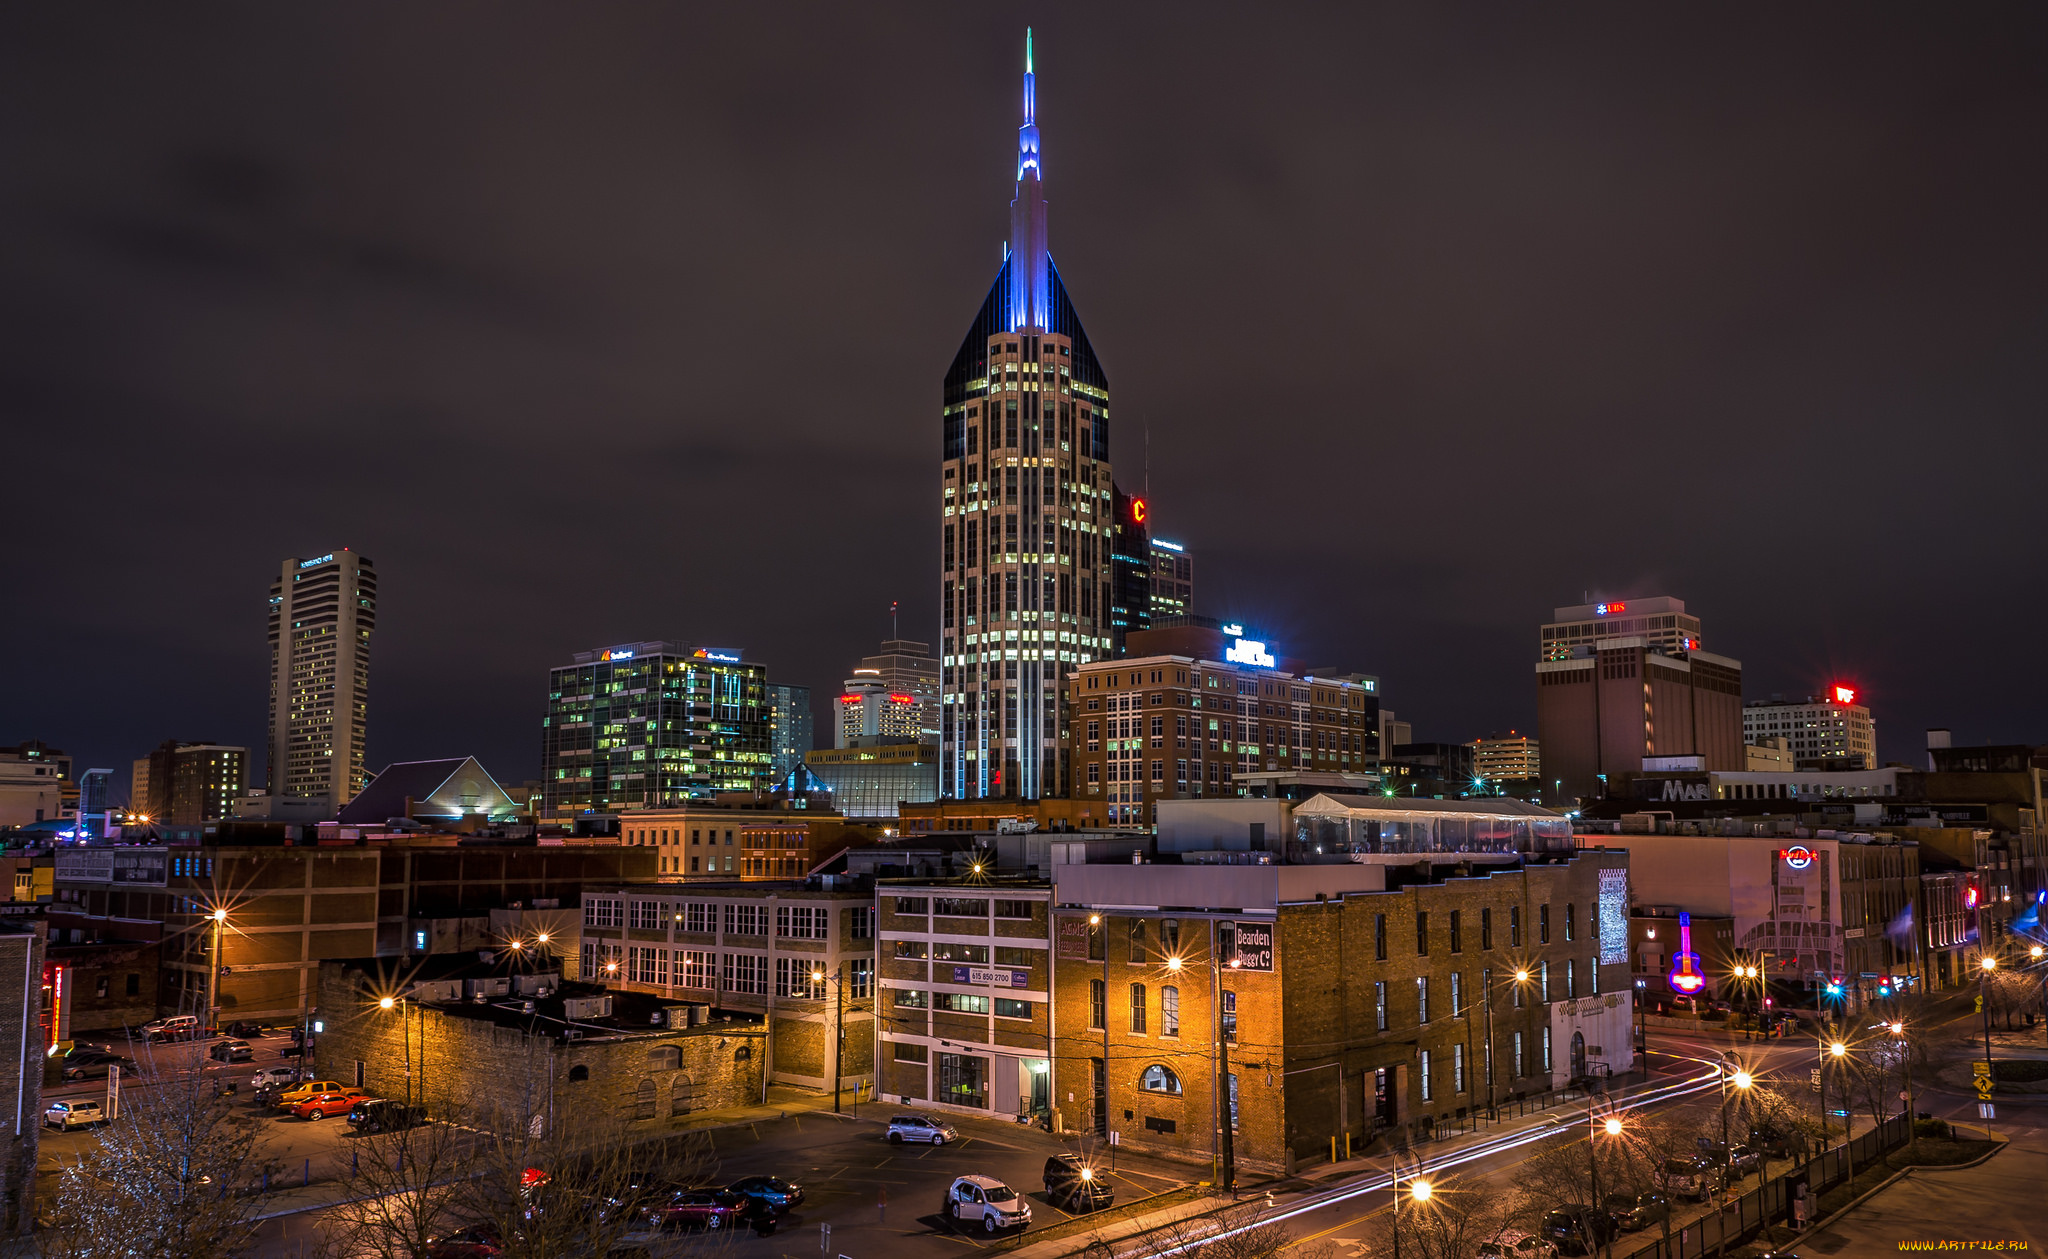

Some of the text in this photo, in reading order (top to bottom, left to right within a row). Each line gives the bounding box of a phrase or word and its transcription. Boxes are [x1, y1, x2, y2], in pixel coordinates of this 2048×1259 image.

[1607, 602, 1625, 613] UBS
[1662, 780, 1710, 801] MAR
[1061, 921, 1085, 937] ACME
[1237, 928, 1270, 946] Bearden
[1237, 949, 1259, 968] Buggy
[972, 972, 982, 980] 615
[982, 973, 993, 981] 850
[994, 974, 1009, 982] 2700
